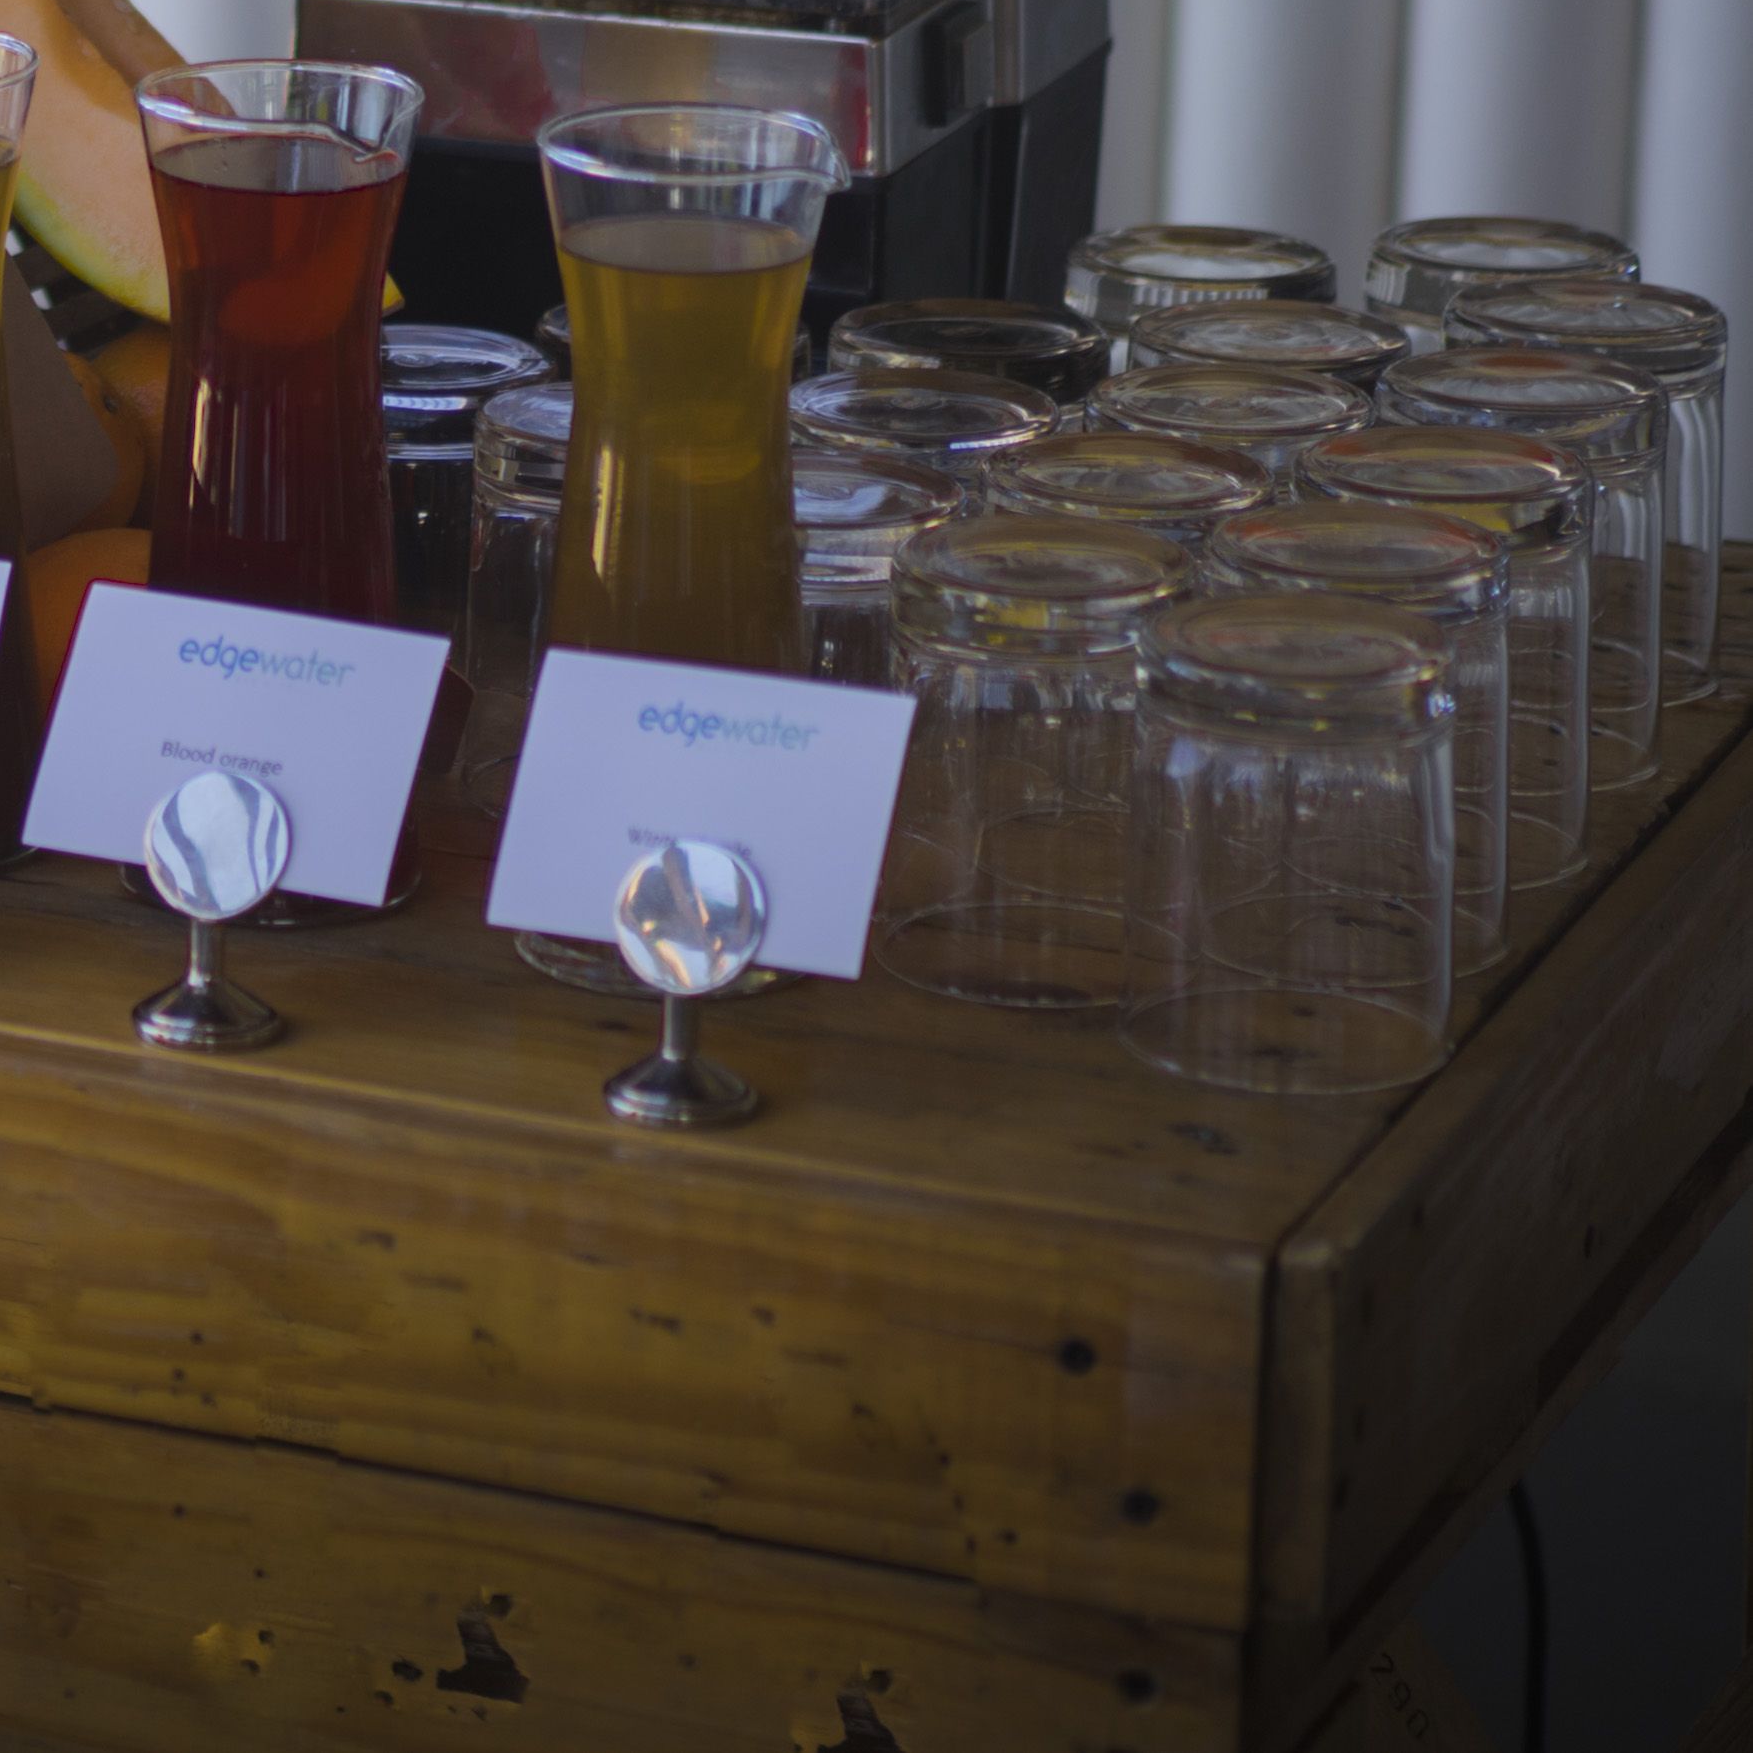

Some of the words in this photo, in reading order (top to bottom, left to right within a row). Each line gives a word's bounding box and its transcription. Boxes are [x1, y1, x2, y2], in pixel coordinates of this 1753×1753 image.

[179, 635, 357, 687] edgewater
[638, 701, 819, 751] edgewater
[161, 741, 217, 765] Blood
[219, 751, 283, 778] orange
